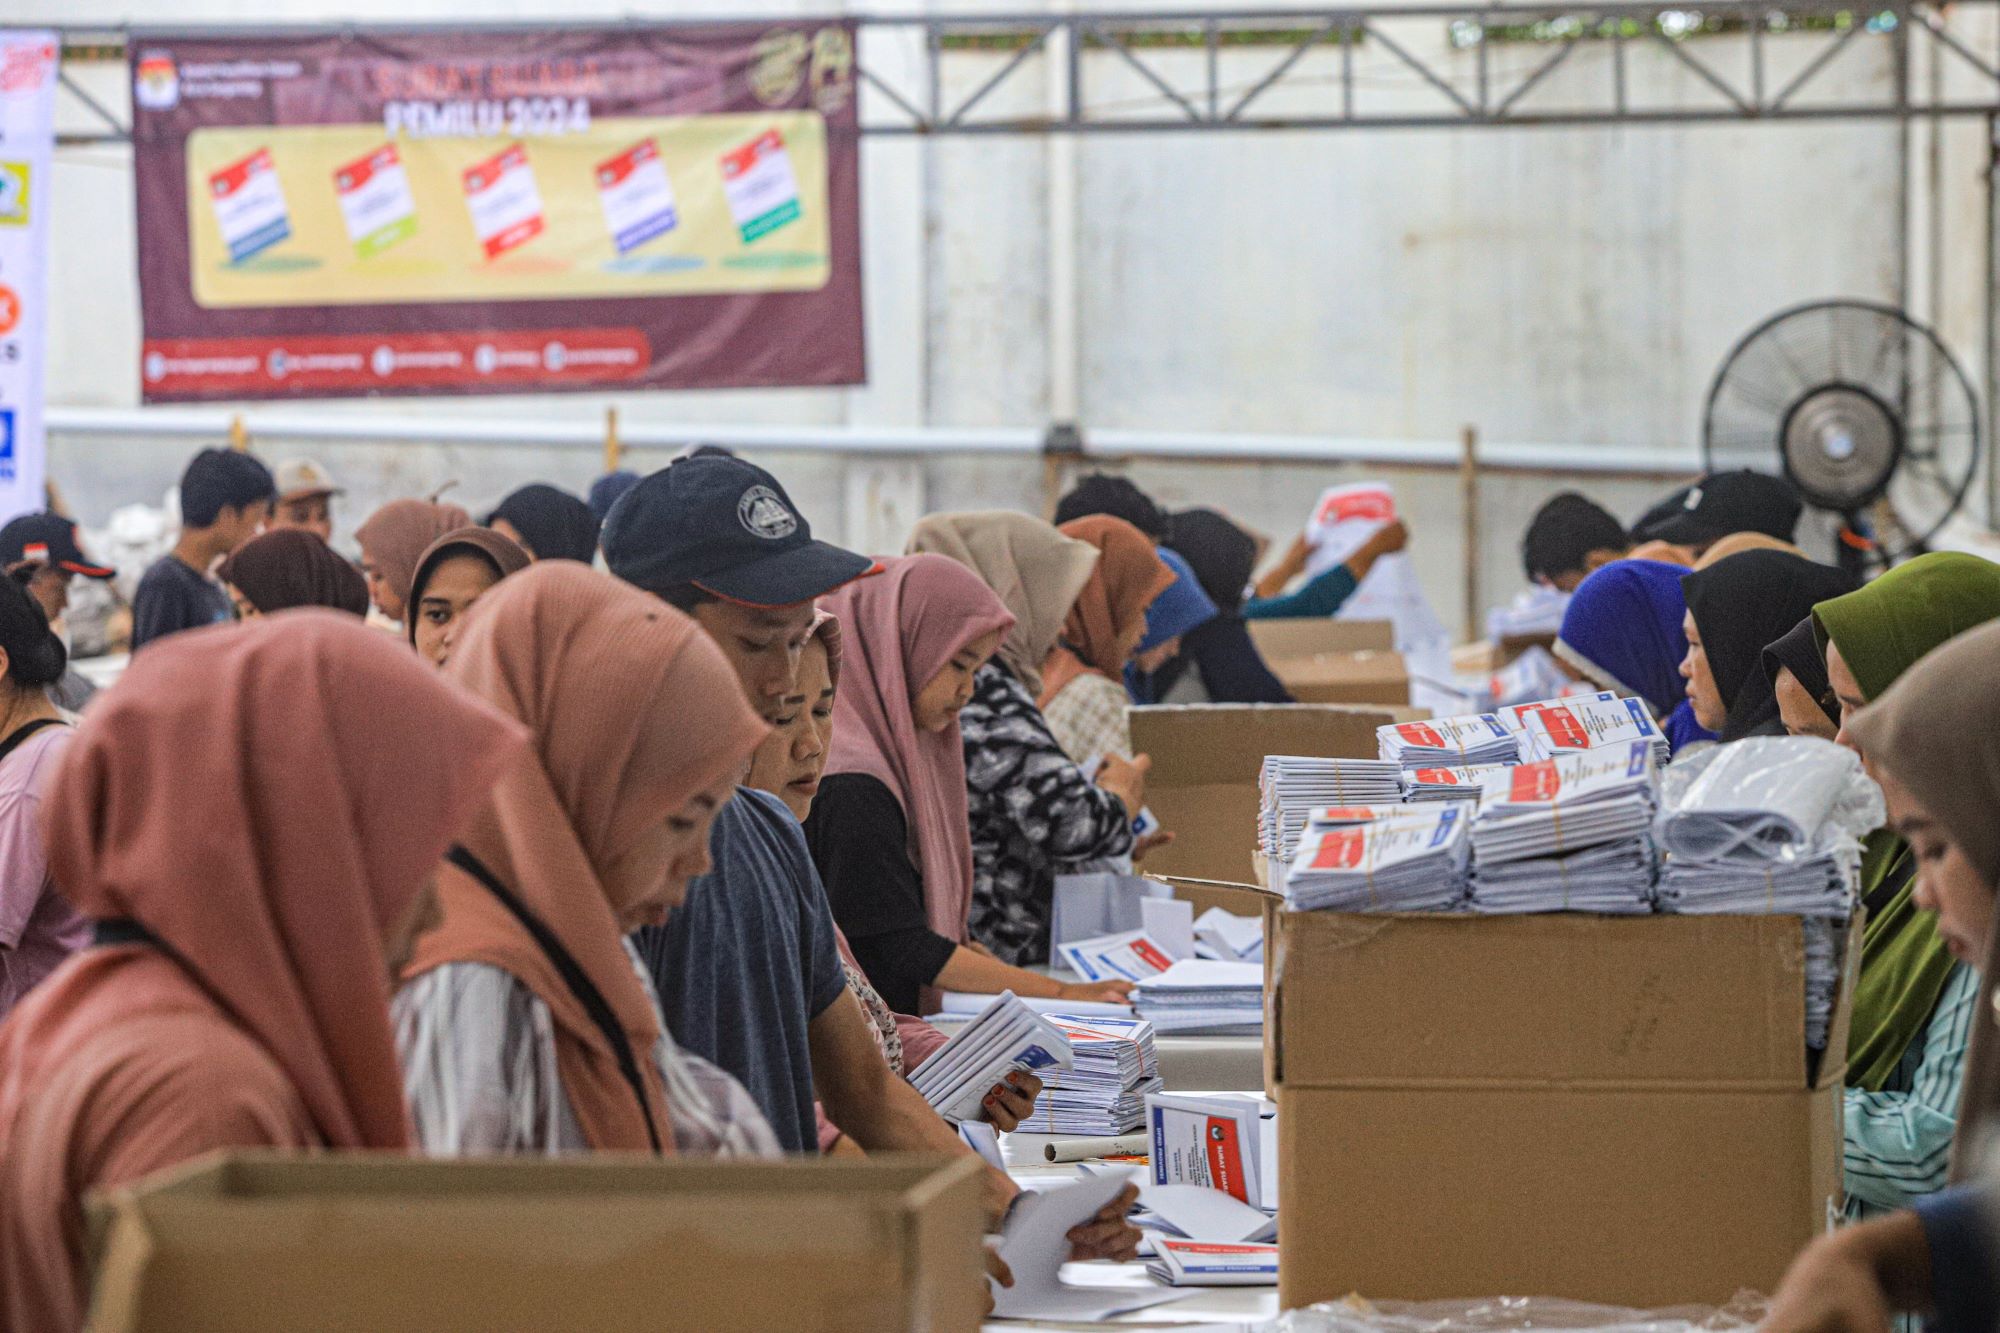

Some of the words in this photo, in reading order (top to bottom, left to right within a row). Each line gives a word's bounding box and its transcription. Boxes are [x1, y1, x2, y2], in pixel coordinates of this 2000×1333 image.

[383, 100, 503, 139] PEMILU
[507, 96, 592, 136] 2024
[1157, 1147, 1165, 1180] PROVINSI
[1216, 1145, 1225, 1169] SURAT
